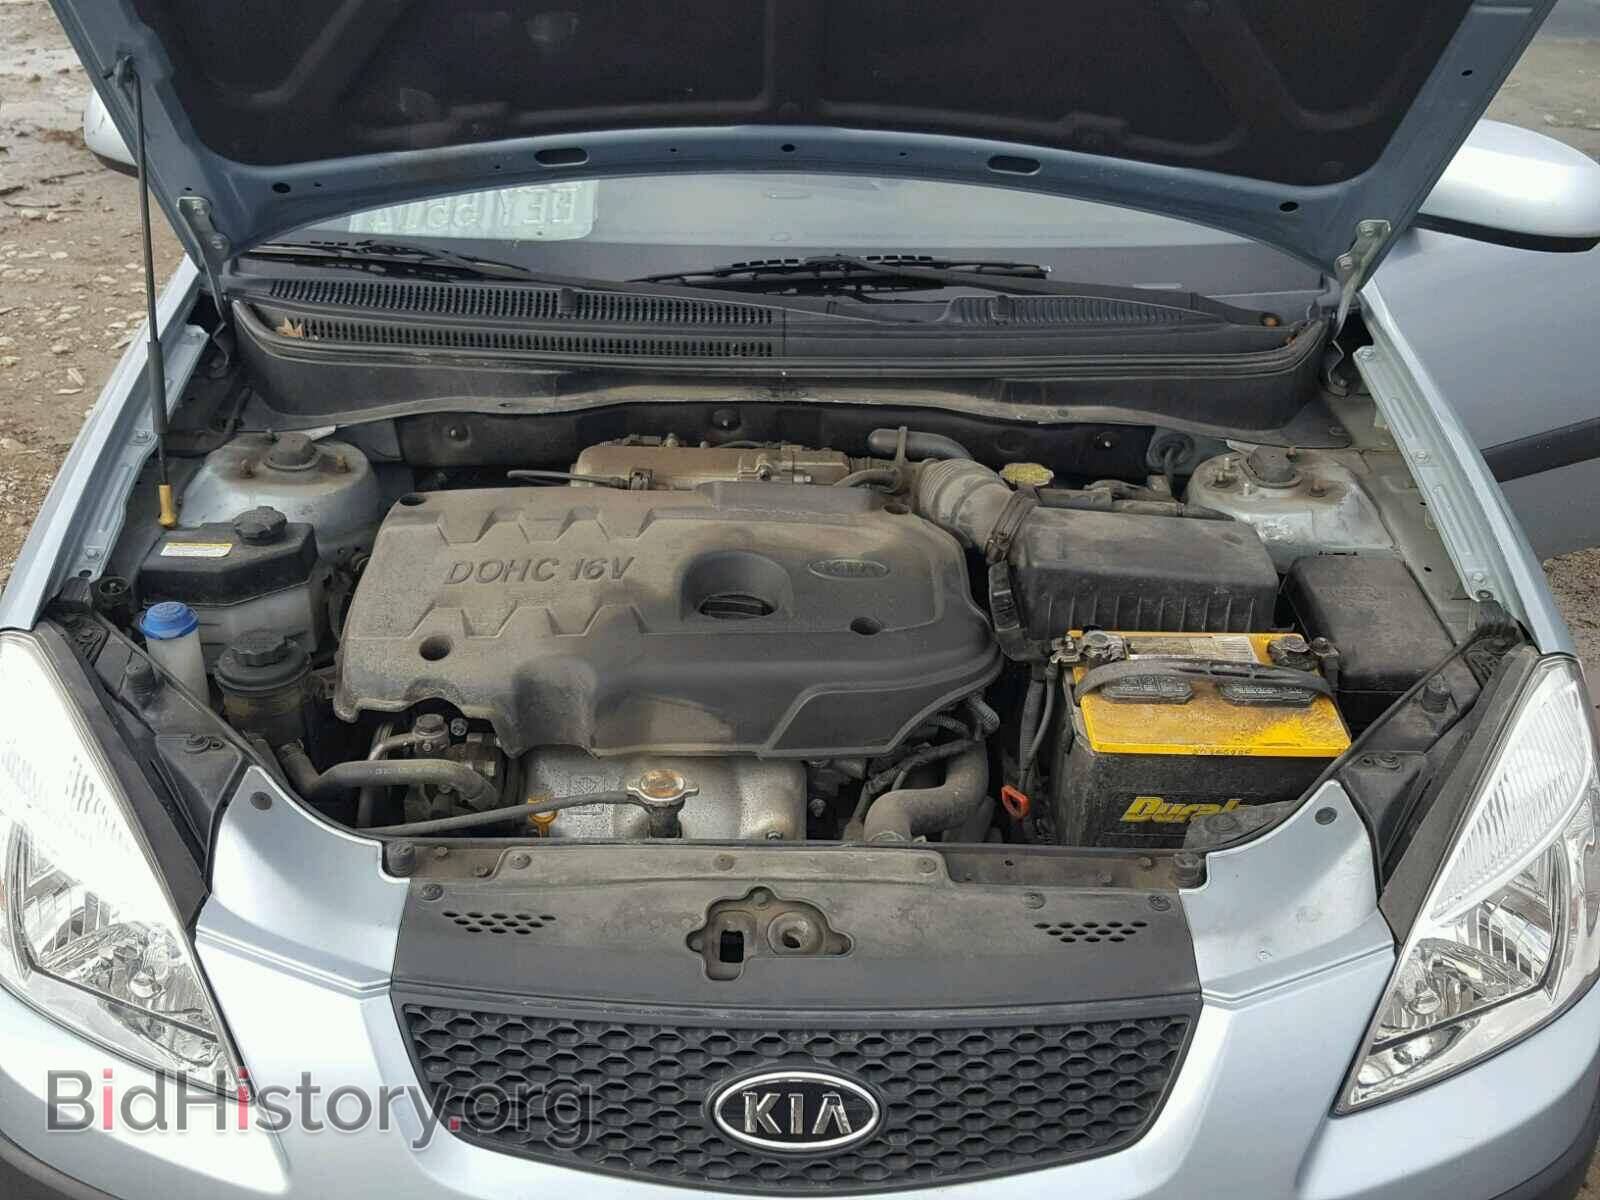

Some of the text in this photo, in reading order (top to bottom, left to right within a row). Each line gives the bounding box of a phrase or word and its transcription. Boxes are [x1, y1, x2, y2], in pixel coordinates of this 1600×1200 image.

[444, 556, 635, 585] DOHC 16V
[743, 1091, 853, 1135] KIA
